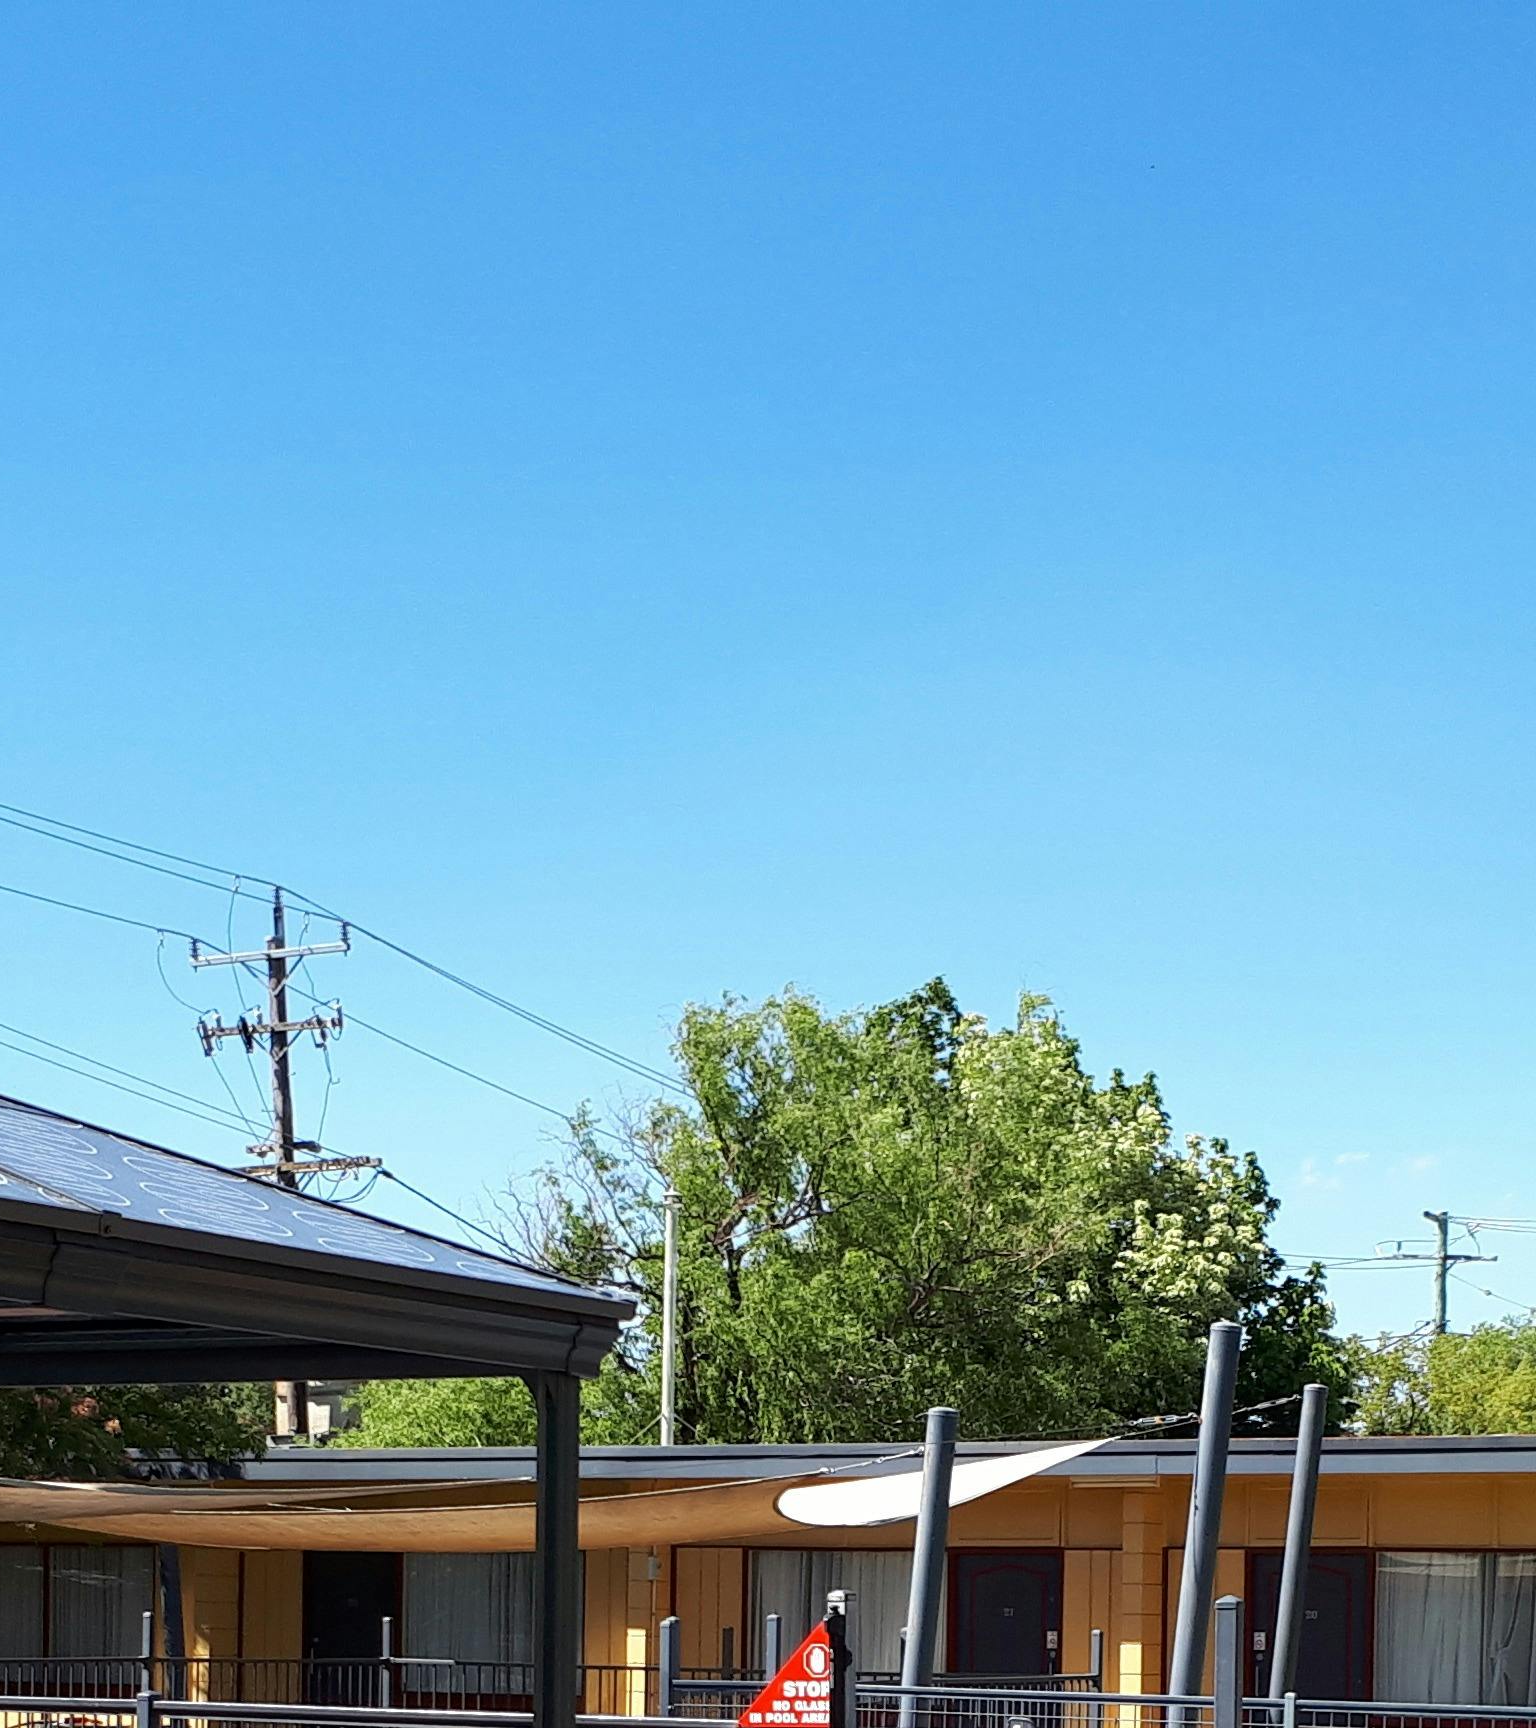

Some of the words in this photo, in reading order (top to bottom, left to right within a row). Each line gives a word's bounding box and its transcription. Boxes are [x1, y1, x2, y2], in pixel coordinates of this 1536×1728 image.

[772, 1700, 791, 1711] NO
[749, 1712, 762, 1723] IN
[765, 1712, 799, 1723] POOL
